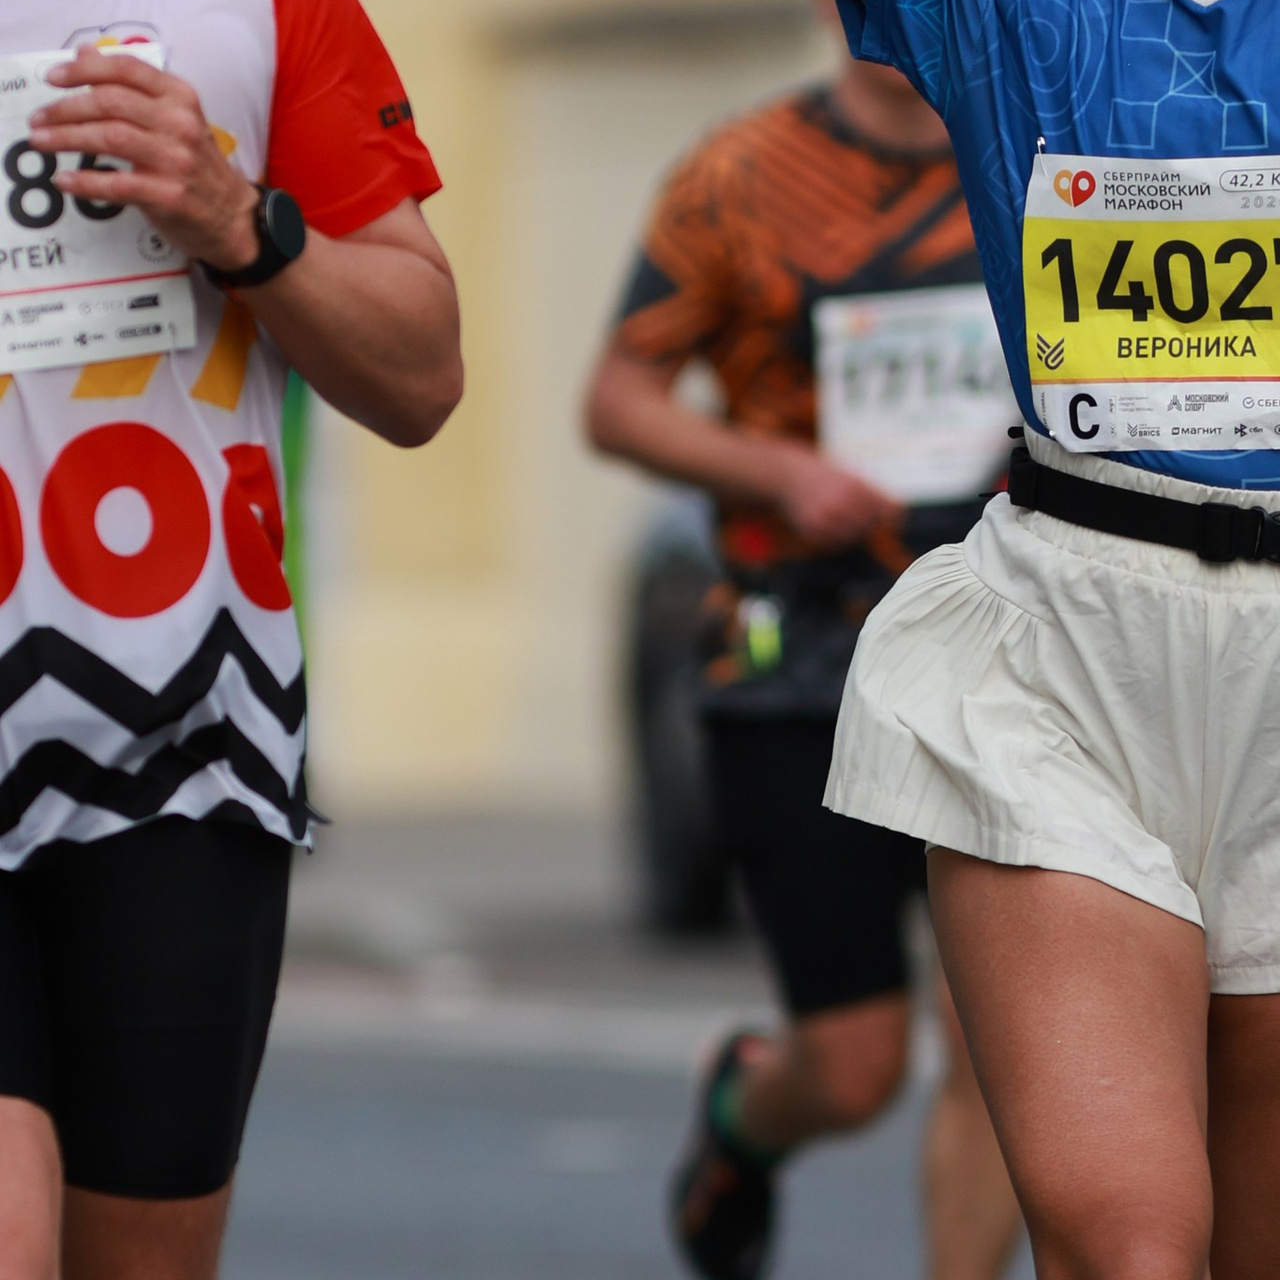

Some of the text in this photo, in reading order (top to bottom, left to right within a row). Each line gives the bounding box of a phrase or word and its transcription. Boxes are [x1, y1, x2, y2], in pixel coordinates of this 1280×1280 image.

[1103, 171, 1181, 183] СБЕРПРАЙМ
[1229, 173, 1265, 188] 42,2
[1104, 182, 1211, 197] МОСКОВСКИЙ
[1104, 198, 1183, 211] МАРАФОН
[1117, 335, 1257, 359] ВЕРОНИКА
[1184, 392, 1229, 403] МОСКОВСКИЙ
[1184, 403, 1206, 412] СПОРТ
[1068, 392, 1100, 440] C
